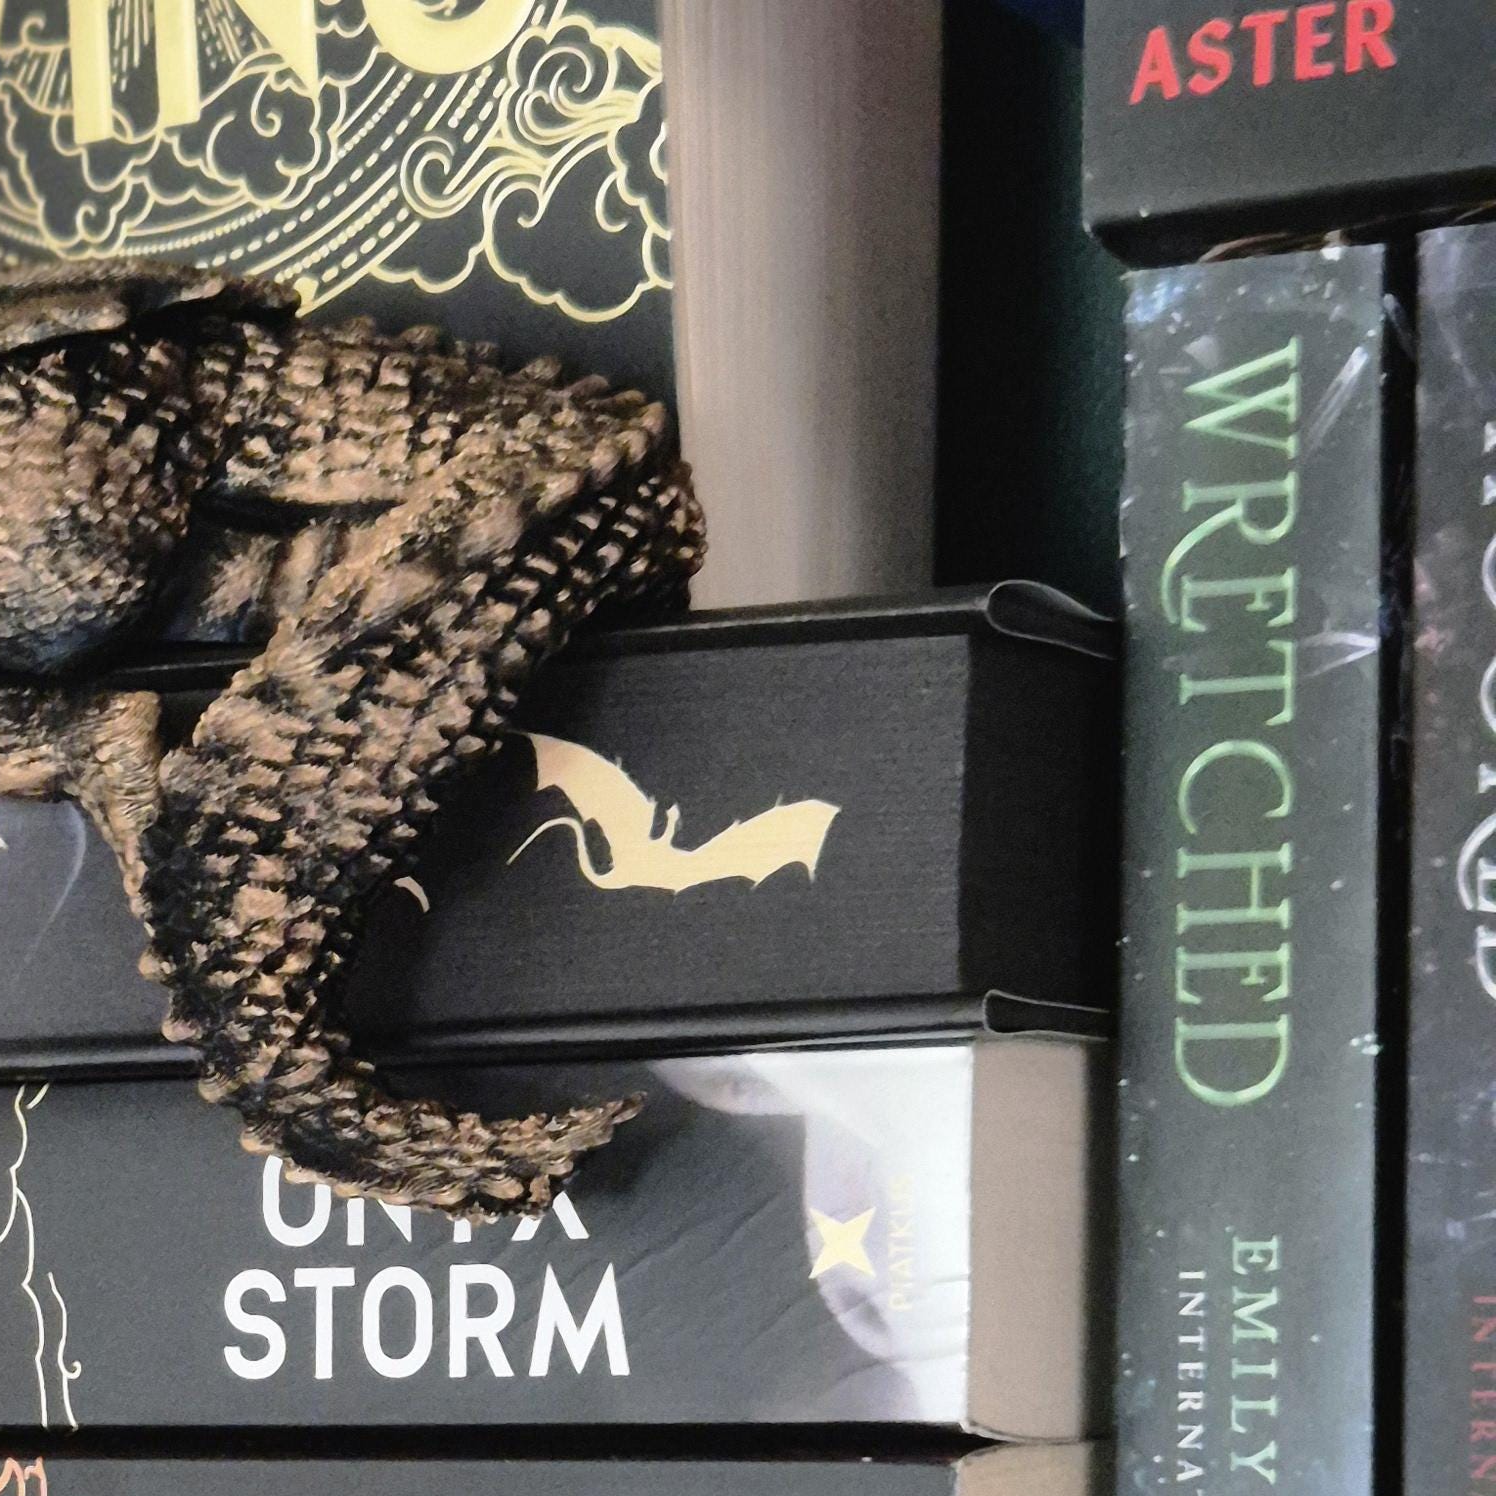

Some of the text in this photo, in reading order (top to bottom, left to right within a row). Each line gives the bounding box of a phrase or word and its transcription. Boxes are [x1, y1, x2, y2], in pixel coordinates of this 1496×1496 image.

[1129, 0, 1397, 105] ASTER
[1160, 336, 1300, 1107] WRETCHED
[223, 1262, 631, 1380] STORM
[1229, 1235, 1282, 1486] EMILY
